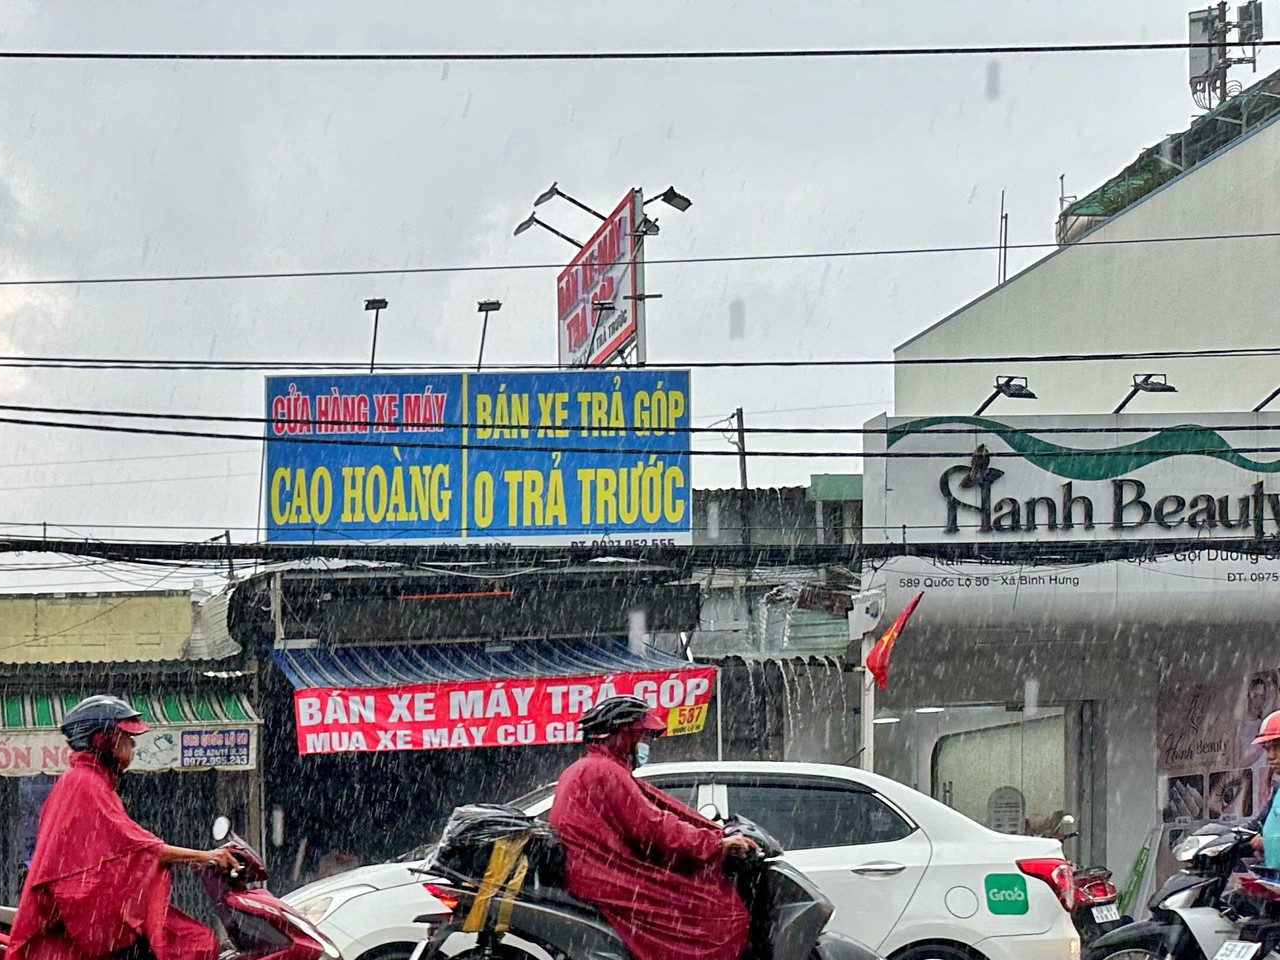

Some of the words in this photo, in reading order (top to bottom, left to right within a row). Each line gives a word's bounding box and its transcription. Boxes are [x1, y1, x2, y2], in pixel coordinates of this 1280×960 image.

[273, 383, 312, 435] CỬA
[316, 387, 369, 434] HÀNG
[373, 394, 398, 433] XE
[403, 385, 447, 432] MÁY
[476, 383, 529, 439] BÁN
[537, 393, 569, 438] XE
[577, 376, 627, 437] TRẢ
[633, 381, 685, 436] GÓP
[271, 466, 332, 525] CAO
[341, 446, 452, 523] HOÀNG
[504, 451, 567, 527] TRẢ
[577, 454, 685, 524] TRƯỚC
[899, 578, 920, 588] 589
[976, 577, 989, 587] 50
[298, 690, 376, 726] BÁN
[388, 692, 436, 722] XE
[449, 682, 535, 719] MÁY
[633, 673, 709, 709] GÓP
[678, 706, 702, 725] 587
[305, 731, 367, 753] MUA
[376, 730, 413, 750] XE
[422, 723, 486, 748] MÁY
[496, 721, 535, 745] CŨ
[989, 887, 1025, 901] Grab
